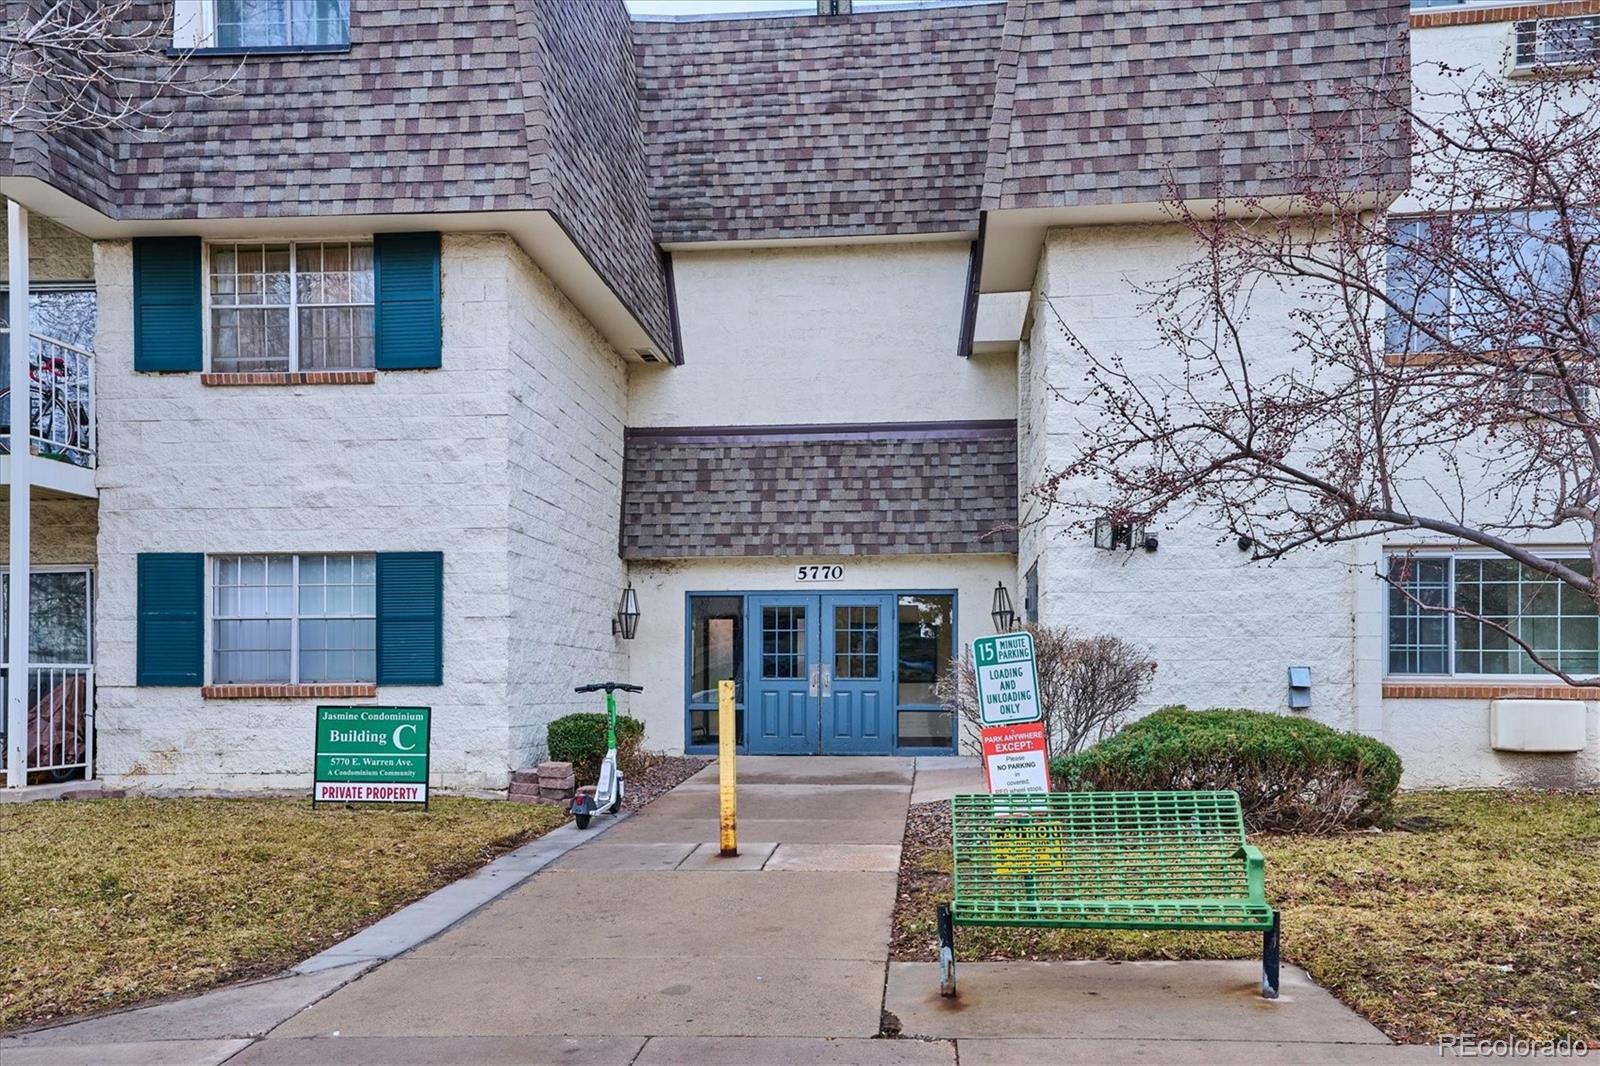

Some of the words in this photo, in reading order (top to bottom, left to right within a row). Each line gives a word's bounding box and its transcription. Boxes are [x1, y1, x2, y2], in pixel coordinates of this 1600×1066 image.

[798, 566, 843, 580] 5770
[1000, 639, 1026, 649] MINUTE
[979, 643, 994, 661] 15
[999, 648, 1029, 660] PARKING
[989, 667, 1023, 680] LOADING
[1000, 680, 1016, 691] AND
[987, 690, 1031, 704] UNLOADING
[1000, 703, 1020, 715] ONLY
[322, 711, 359, 721] Jasmine
[360, 711, 424, 721] Condominium
[330, 730, 387, 746] Building
[392, 724, 417, 751] C
[1004, 731, 1042, 741] ANYWHERE
[995, 741, 1034, 752] EXCEPT:
[330, 758, 350, 766] 5770
[352, 758, 361, 766] E.
[363, 758, 394, 766] Warren
[395, 758, 414, 767] Ave.
[1007, 761, 1036, 770] PARKING
[379, 769, 416, 777] Community
[322, 786, 363, 799] PRIVATE
[366, 787, 418, 800] PROPERTY
